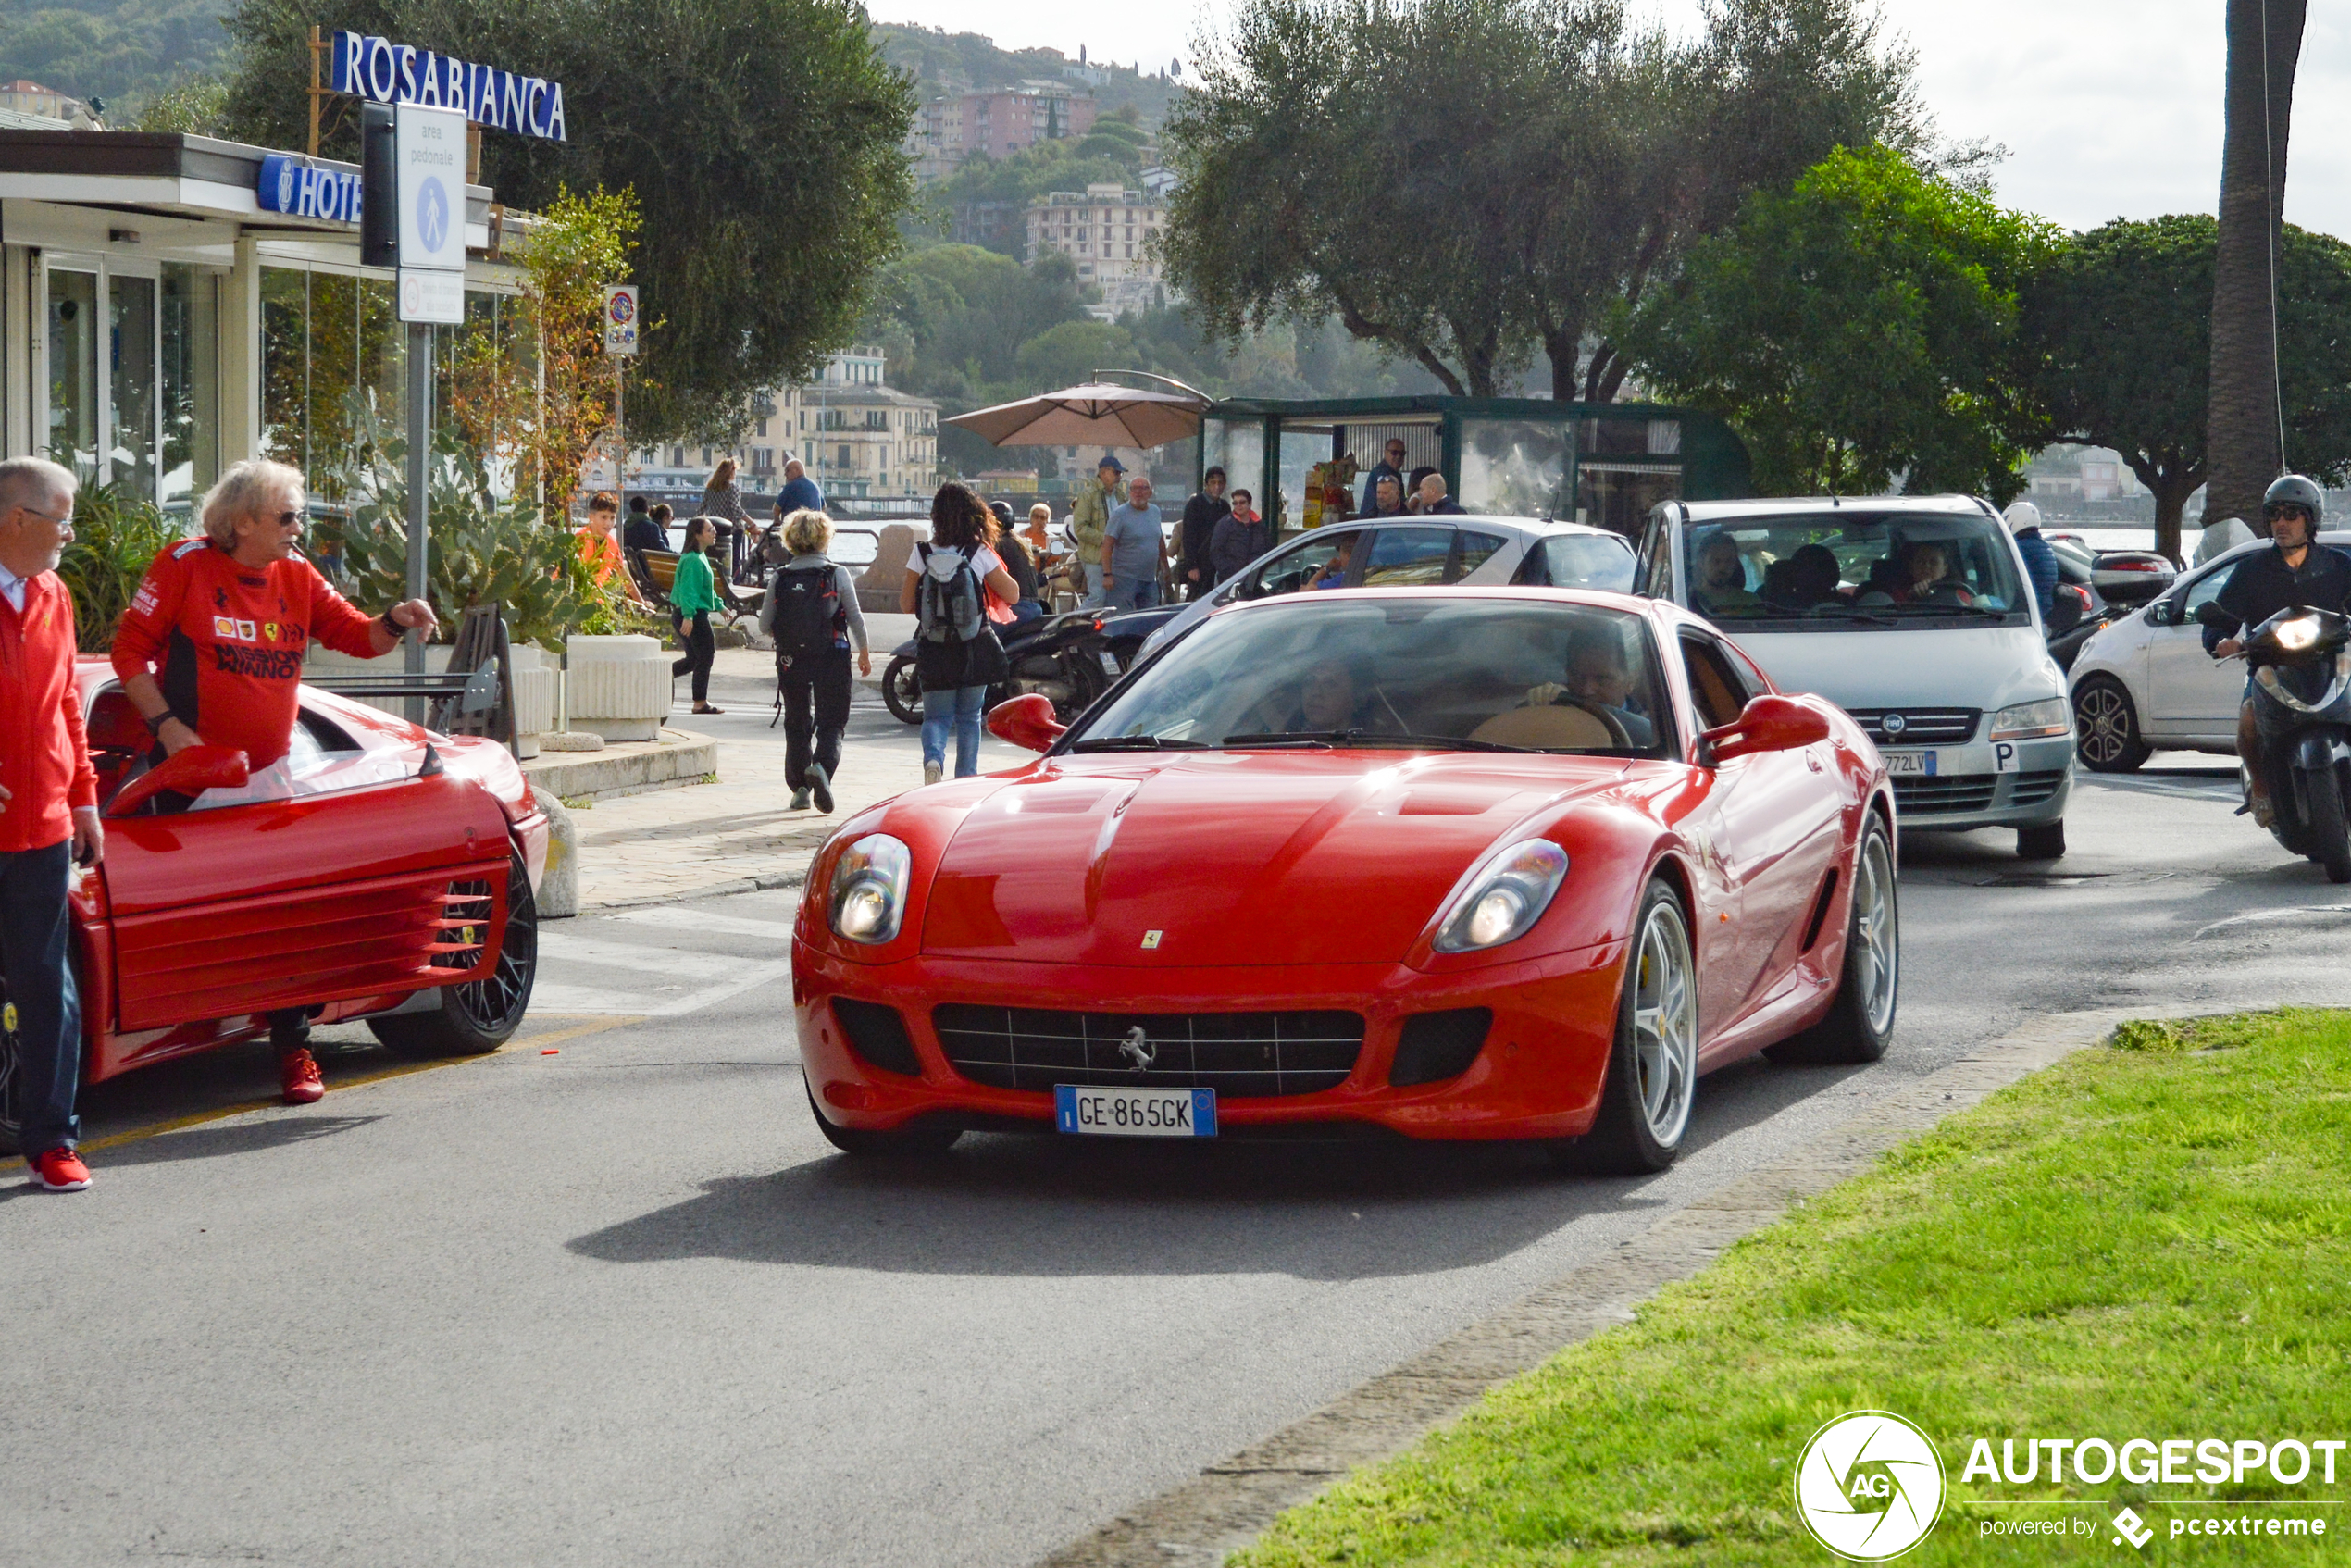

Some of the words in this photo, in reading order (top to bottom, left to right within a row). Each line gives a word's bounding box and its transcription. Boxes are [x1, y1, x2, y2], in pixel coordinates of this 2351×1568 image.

[333, 31, 566, 142] ROSABIANCA
[421, 125, 442, 140] area
[411, 146, 454, 166] pedonale
[297, 167, 362, 222] HOTE
[217, 660, 295, 679] WINNO
[1885, 719, 1901, 728] FIAT
[1885, 755, 1924, 772] 772LV
[1995, 743, 2014, 772] P
[1079, 1097, 1107, 1126] GE
[1114, 1099, 1191, 1128] 865GK
